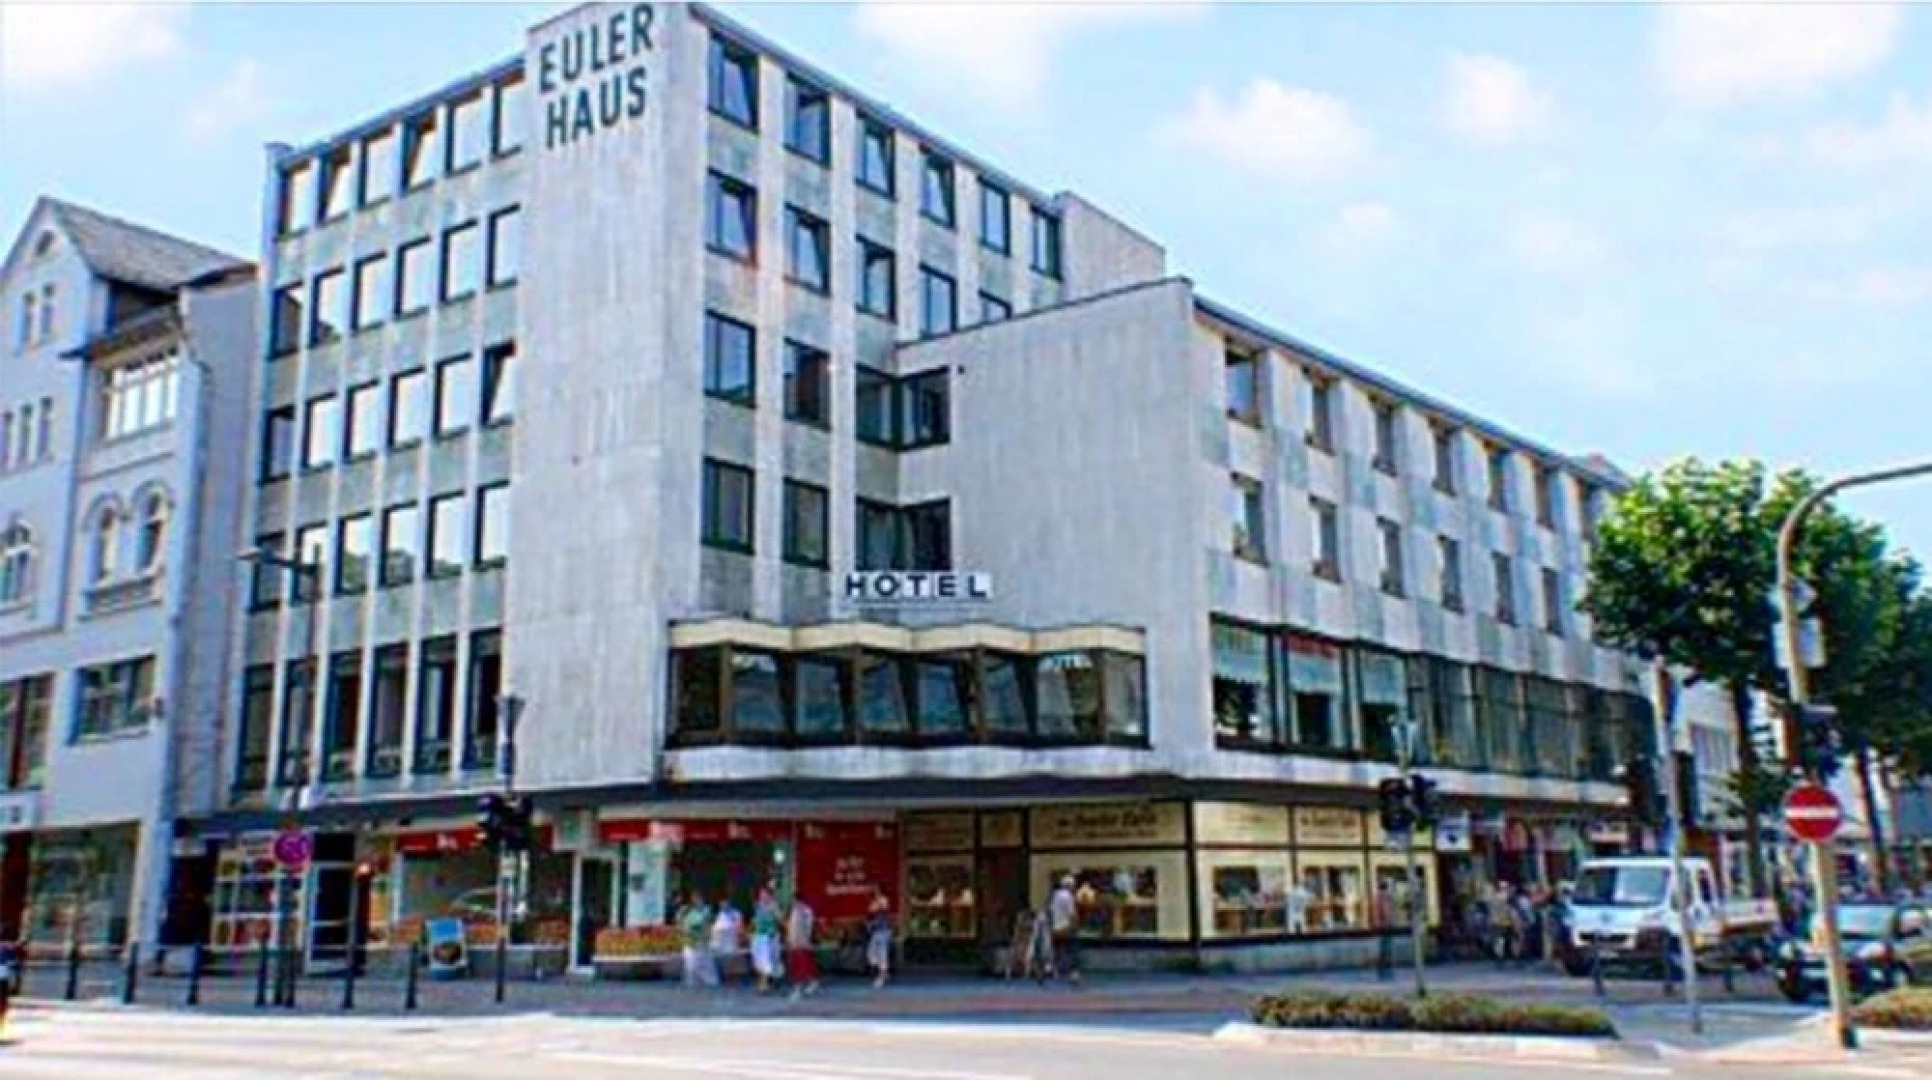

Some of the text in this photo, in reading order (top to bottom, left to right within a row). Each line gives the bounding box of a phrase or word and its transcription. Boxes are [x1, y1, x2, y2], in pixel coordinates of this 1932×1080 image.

[540, 3, 653, 94] EULER
[547, 66, 646, 150] HAUS
[846, 574, 987, 598] HOTEL
